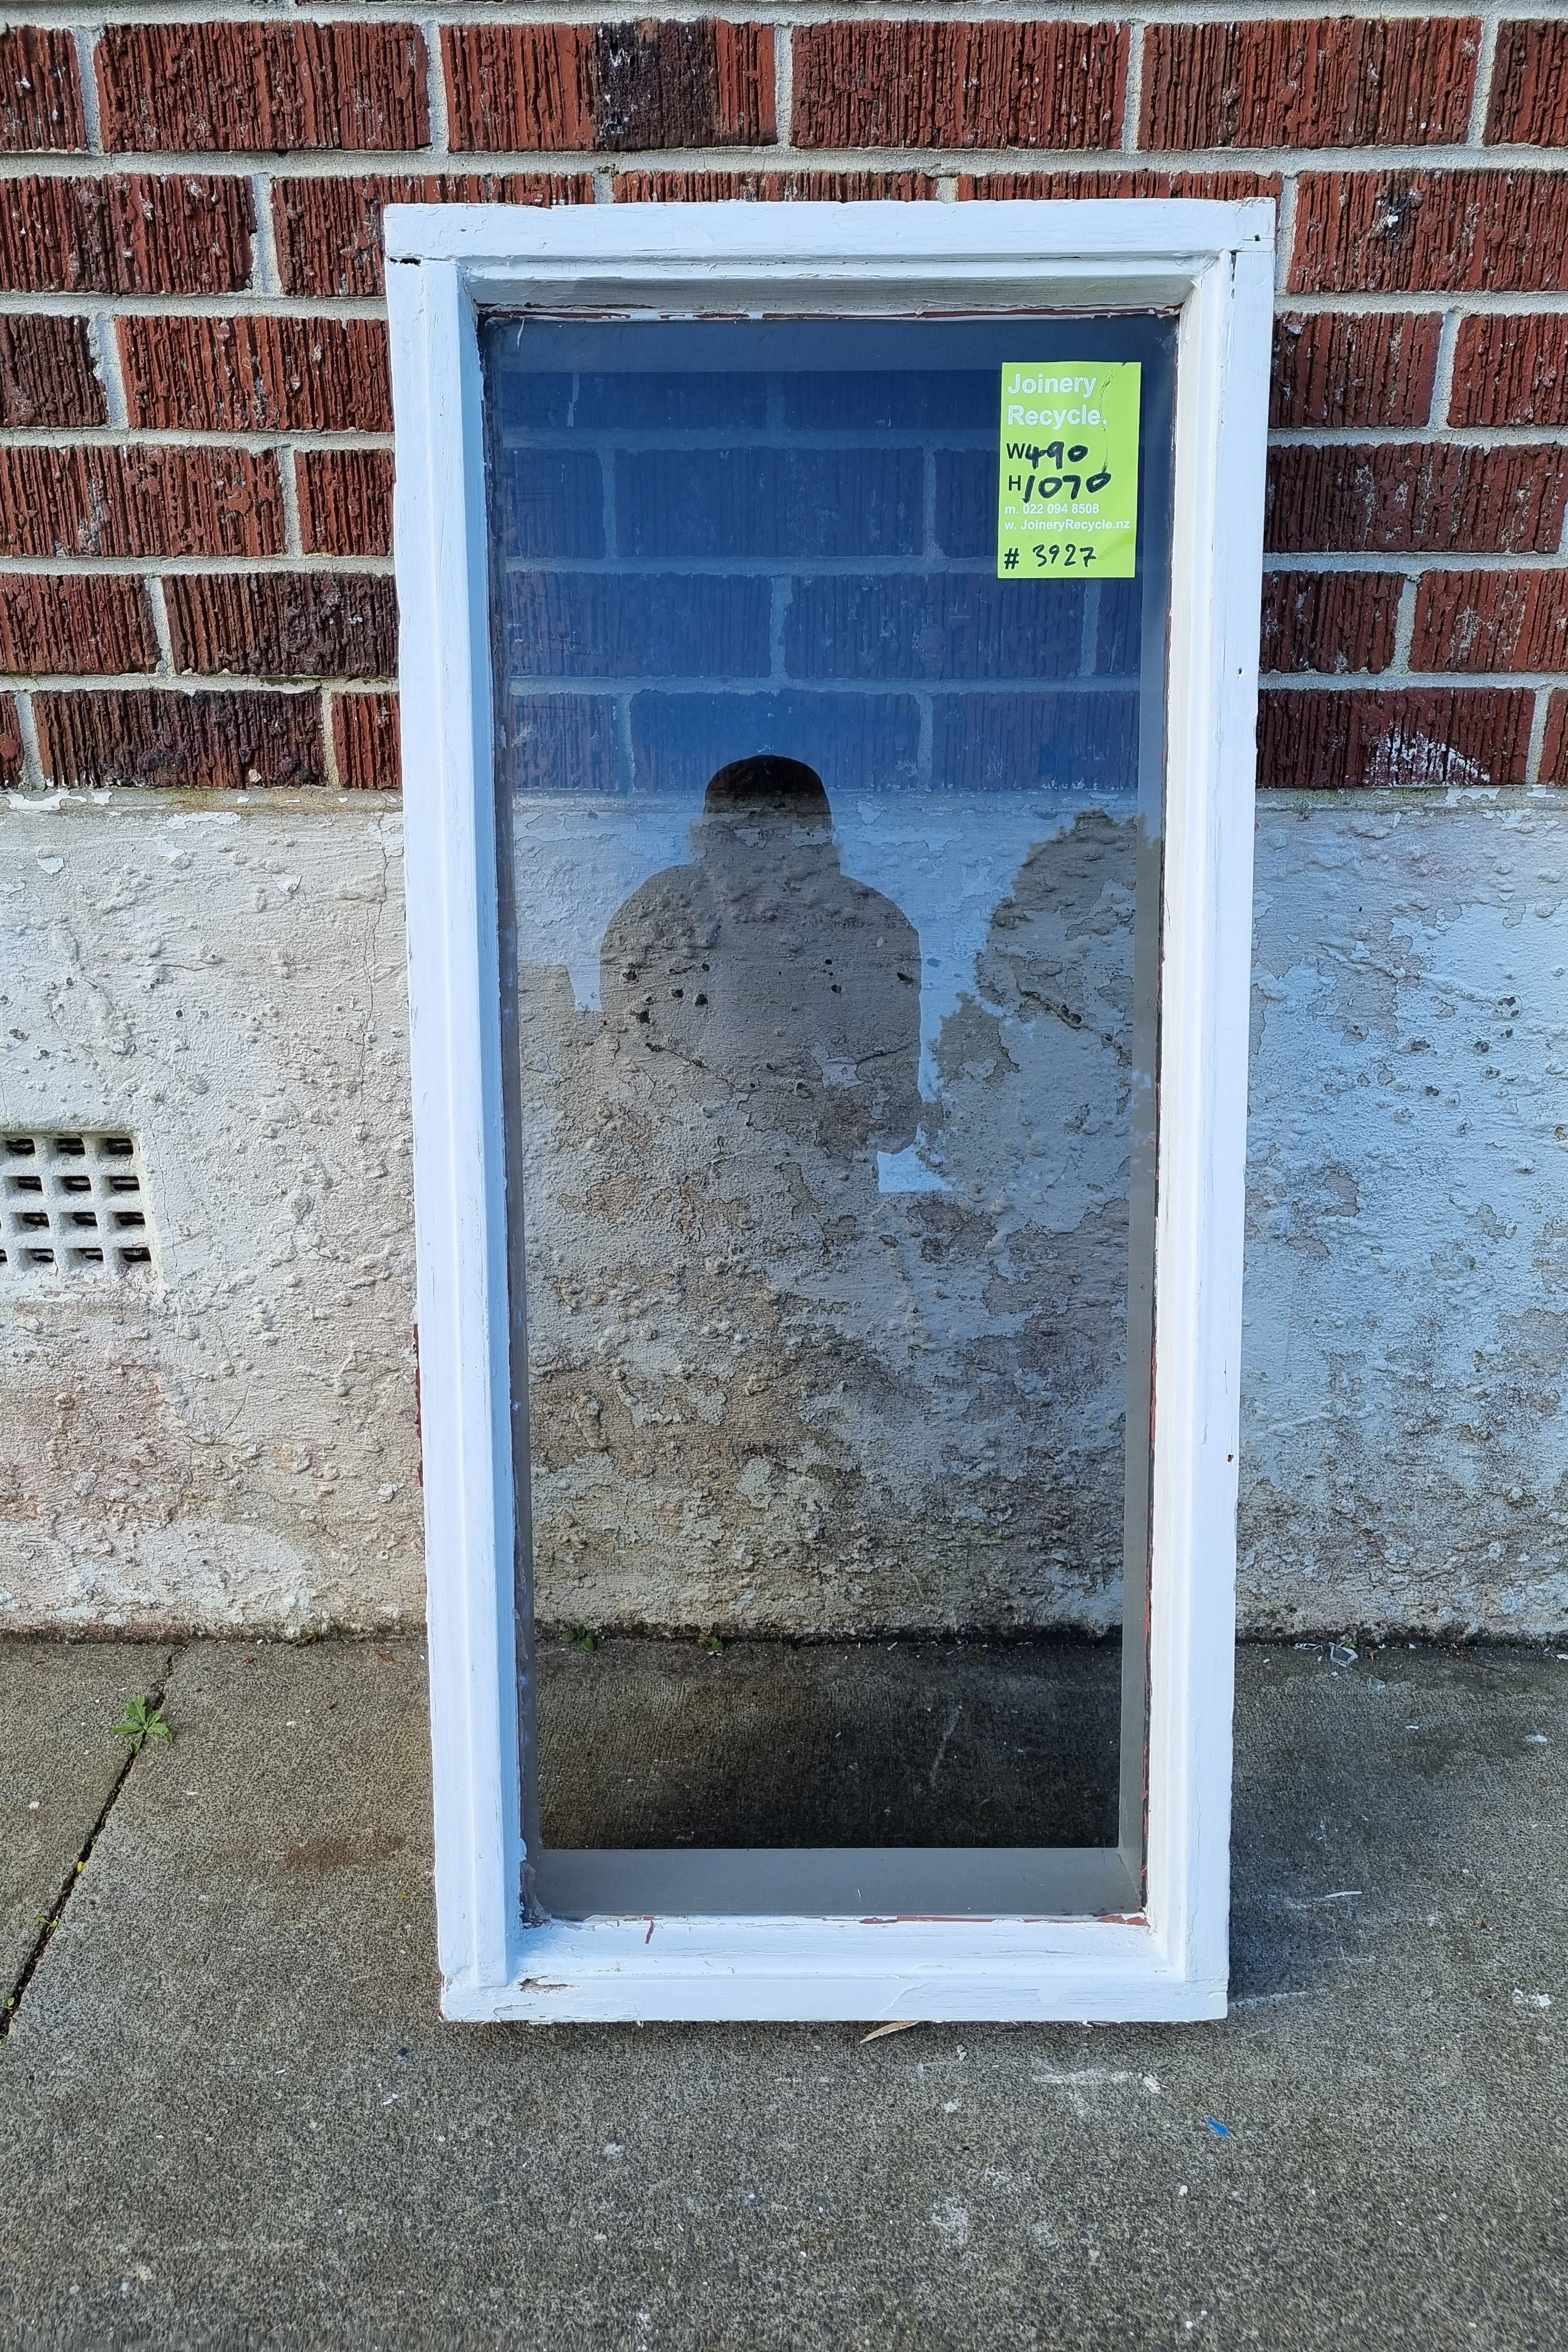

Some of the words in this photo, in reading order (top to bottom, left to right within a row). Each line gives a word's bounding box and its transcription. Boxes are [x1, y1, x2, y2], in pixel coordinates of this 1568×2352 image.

[1008, 373, 1096, 397] Joinery
[1023, 504, 1043, 514] 022
[1048, 503, 1068, 514] 094
[1071, 503, 1099, 513] 8508
[1021, 519, 1130, 532] JoineryRecycle.nz
[1032, 543, 1096, 567] 3927
